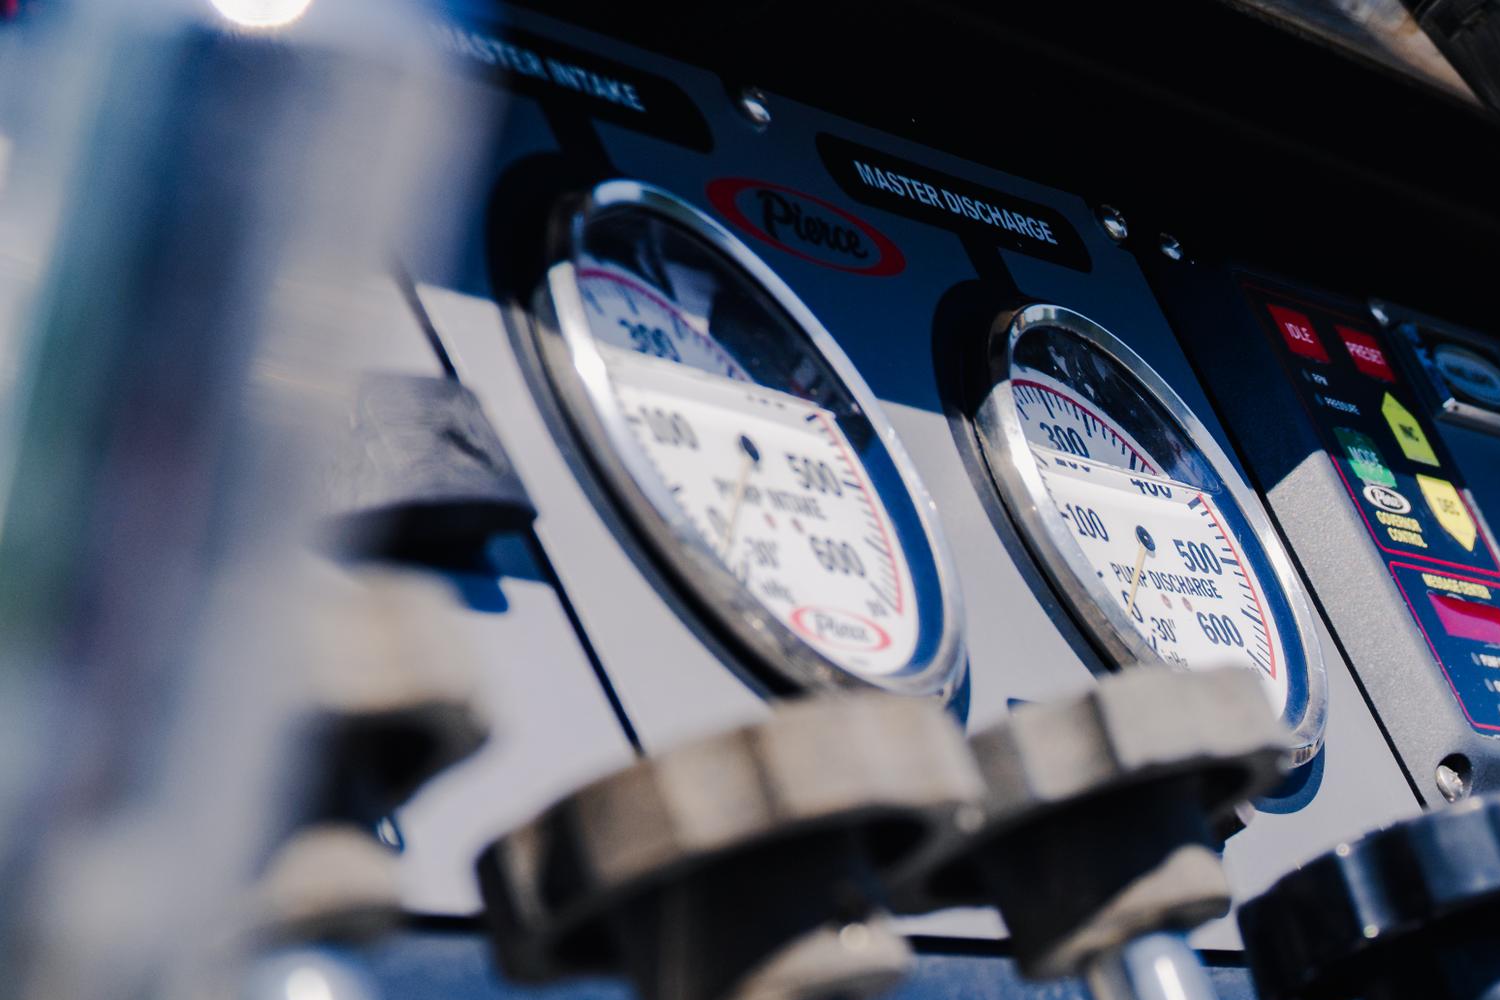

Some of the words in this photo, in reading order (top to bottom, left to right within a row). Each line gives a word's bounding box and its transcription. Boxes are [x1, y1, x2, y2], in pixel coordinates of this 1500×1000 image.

[430, 22, 549, 80] ASTER
[853, 160, 946, 210] MASTER
[940, 188, 1060, 245] DISCHARGE
[756, 188, 870, 261] Pierce
[1285, 322, 1315, 344] IDLE
[1344, 341, 1387, 366] PRESET
[1039, 421, 1091, 459] 300
[784, 451, 845, 498] 500
[1066, 503, 1110, 542] 100
[809, 533, 868, 579] 600
[1173, 538, 1223, 575] 500
[1147, 570, 1223, 600] DISCHARGE
[1196, 611, 1244, 648] 600
